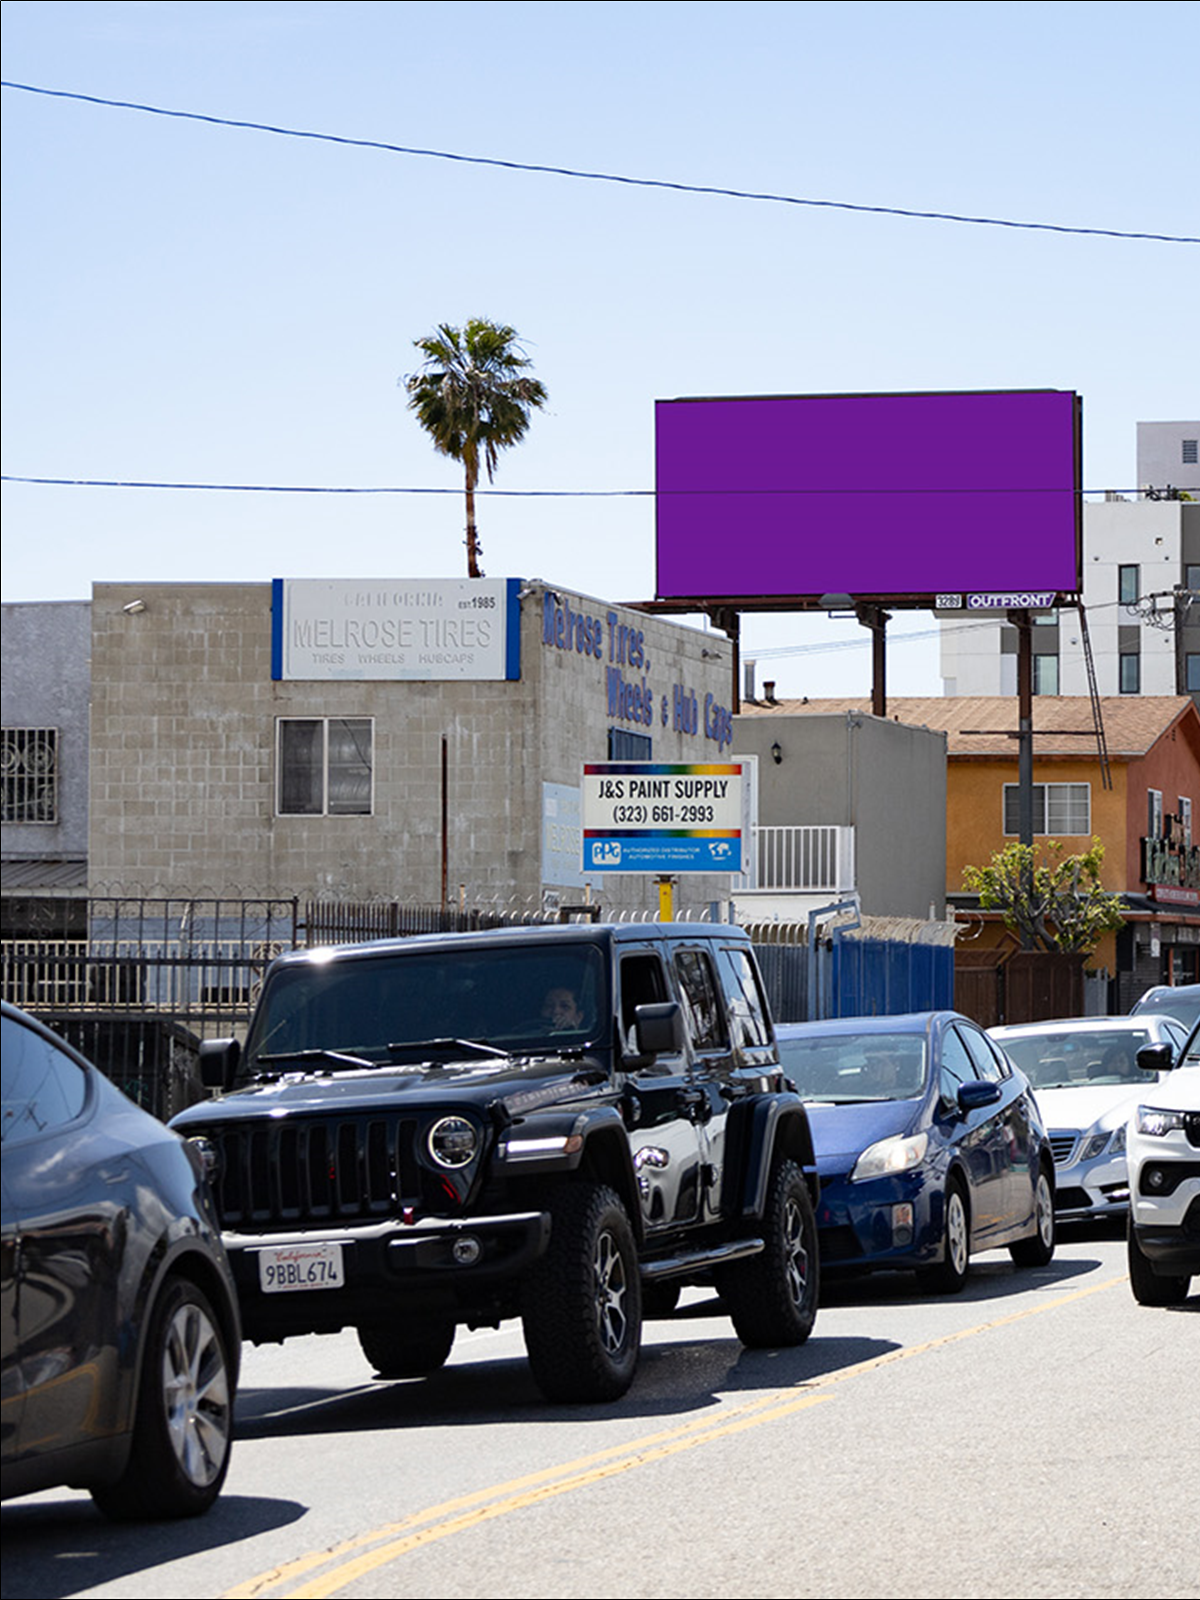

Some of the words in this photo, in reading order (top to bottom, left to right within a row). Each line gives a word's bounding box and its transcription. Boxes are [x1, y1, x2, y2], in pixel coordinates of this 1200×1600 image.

[970, 595, 1050, 607] OUTFRONT
[293, 619, 412, 648] MELROSE
[419, 619, 491, 648] TIRES
[543, 591, 602, 660] Melrose
[312, 653, 345, 664] TIRES
[358, 653, 405, 664] WHEELS
[419, 653, 474, 664] HUBCAPS
[606, 666, 653, 727] Wheels
[673, 683, 698, 736] Hub
[704, 692, 733, 752] Caps
[599, 780, 624, 799] J&S
[629, 780, 671, 799] PAINT
[675, 780, 728, 799] SUPPLY
[613, 805, 648, 824] (323)
[652, 805, 714, 823] 661-2993
[593, 843, 621, 861] PPG
[265, 1261, 338, 1286] 9BBL674
